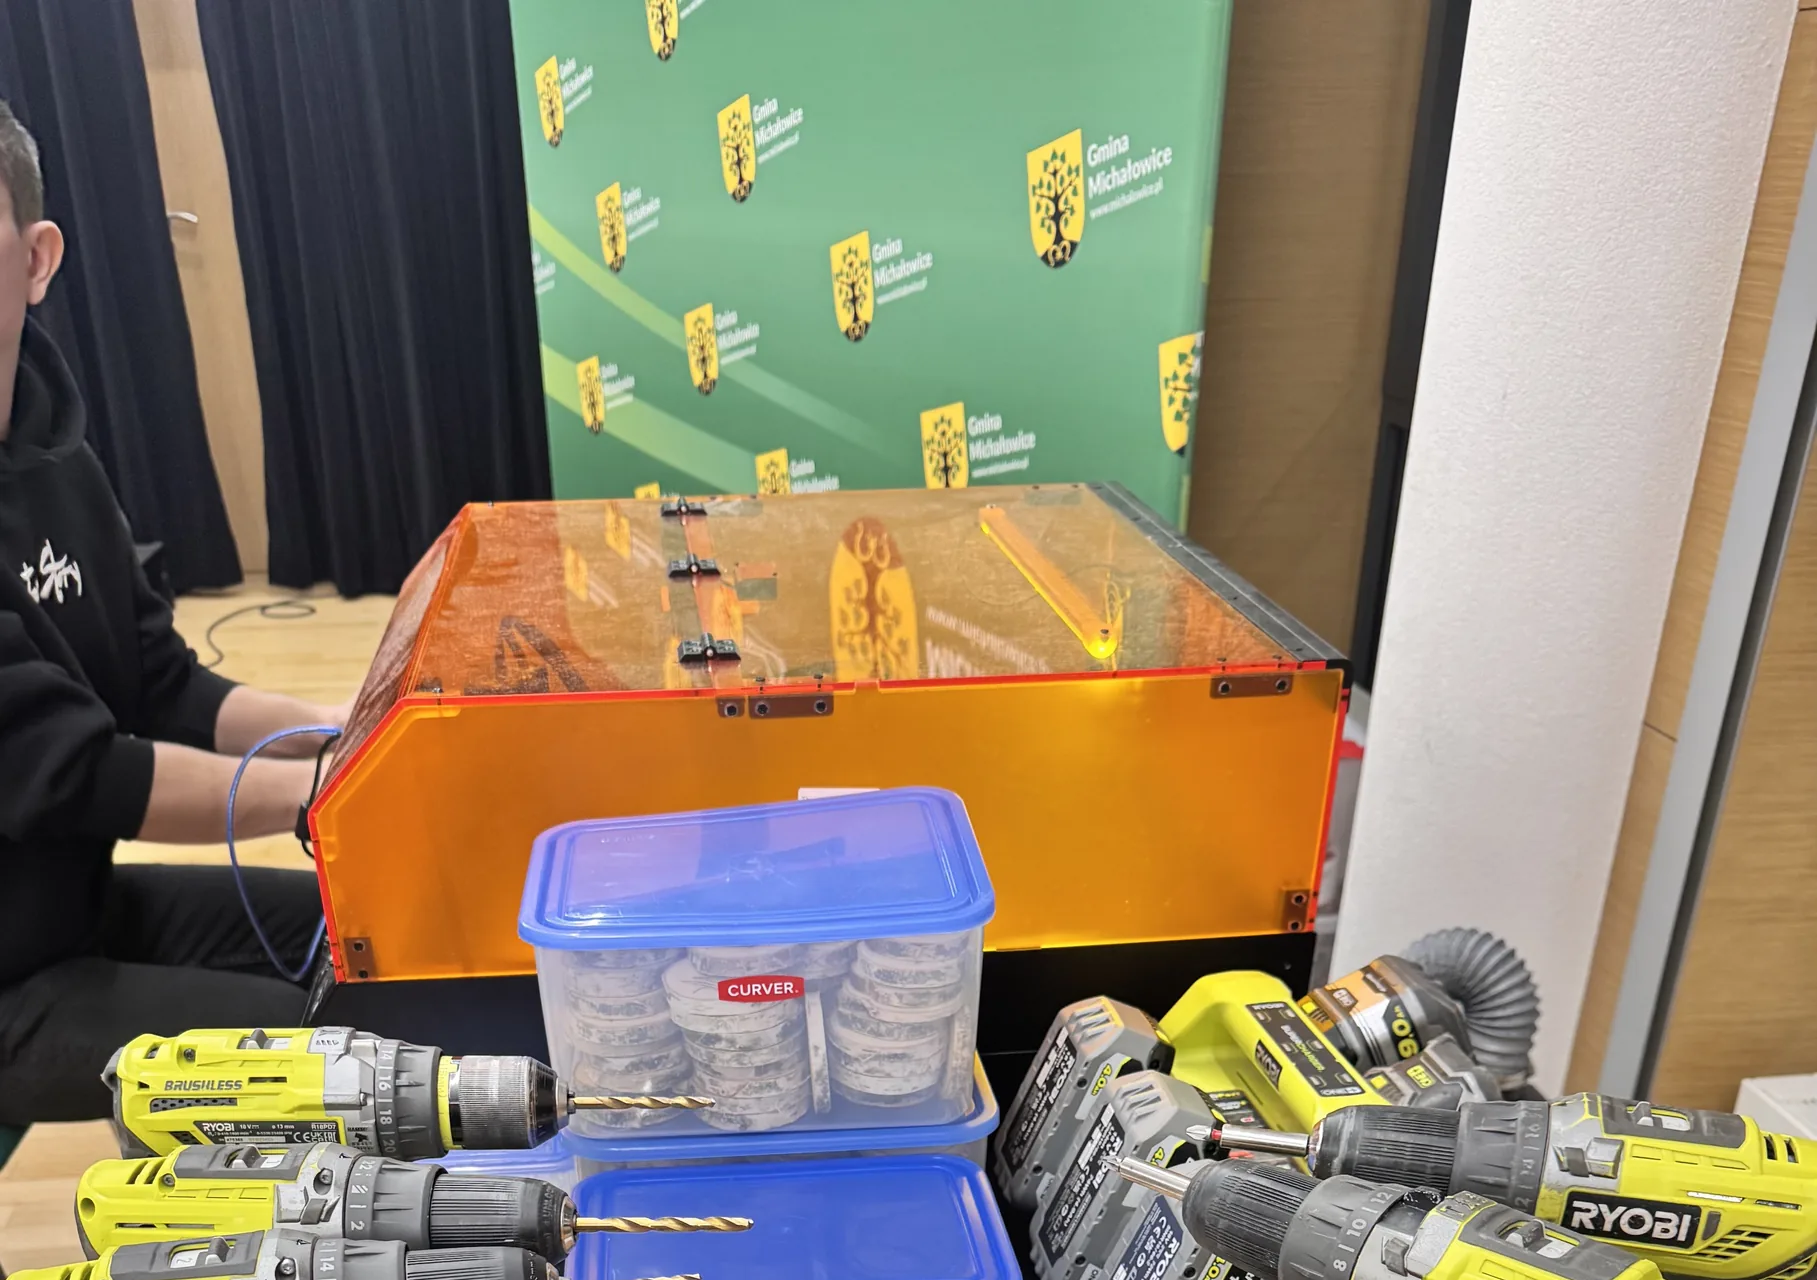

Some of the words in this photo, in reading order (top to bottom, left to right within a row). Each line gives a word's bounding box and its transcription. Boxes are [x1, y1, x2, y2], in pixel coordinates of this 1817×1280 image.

[1087, 134, 1130, 167] Gmina
[1088, 146, 1173, 199] Michałowice
[872, 238, 903, 263] Gmina
[873, 252, 933, 288] Michałowice
[968, 413, 1003, 436] Gmina
[969, 430, 1036, 461] Michałowice
[727, 982, 794, 997] CURVER
[381, 1050, 393, 1060] 14
[164, 1079, 243, 1092] BRUSHLESS
[378, 1075, 392, 1091] 16
[1048, 1054, 1076, 1105] RYOBI
[379, 1109, 392, 1125] 18
[202, 1123, 235, 1132] RYOBI
[383, 1139, 396, 1153] 20
[1370, 1191, 1394, 1204] 12
[351, 1221, 365, 1231] 2
[1346, 1218, 1367, 1237] 10
[1571, 1201, 1693, 1243] RYOBI
[320, 1256, 335, 1272] 14
[1333, 1258, 1347, 1272] 8
